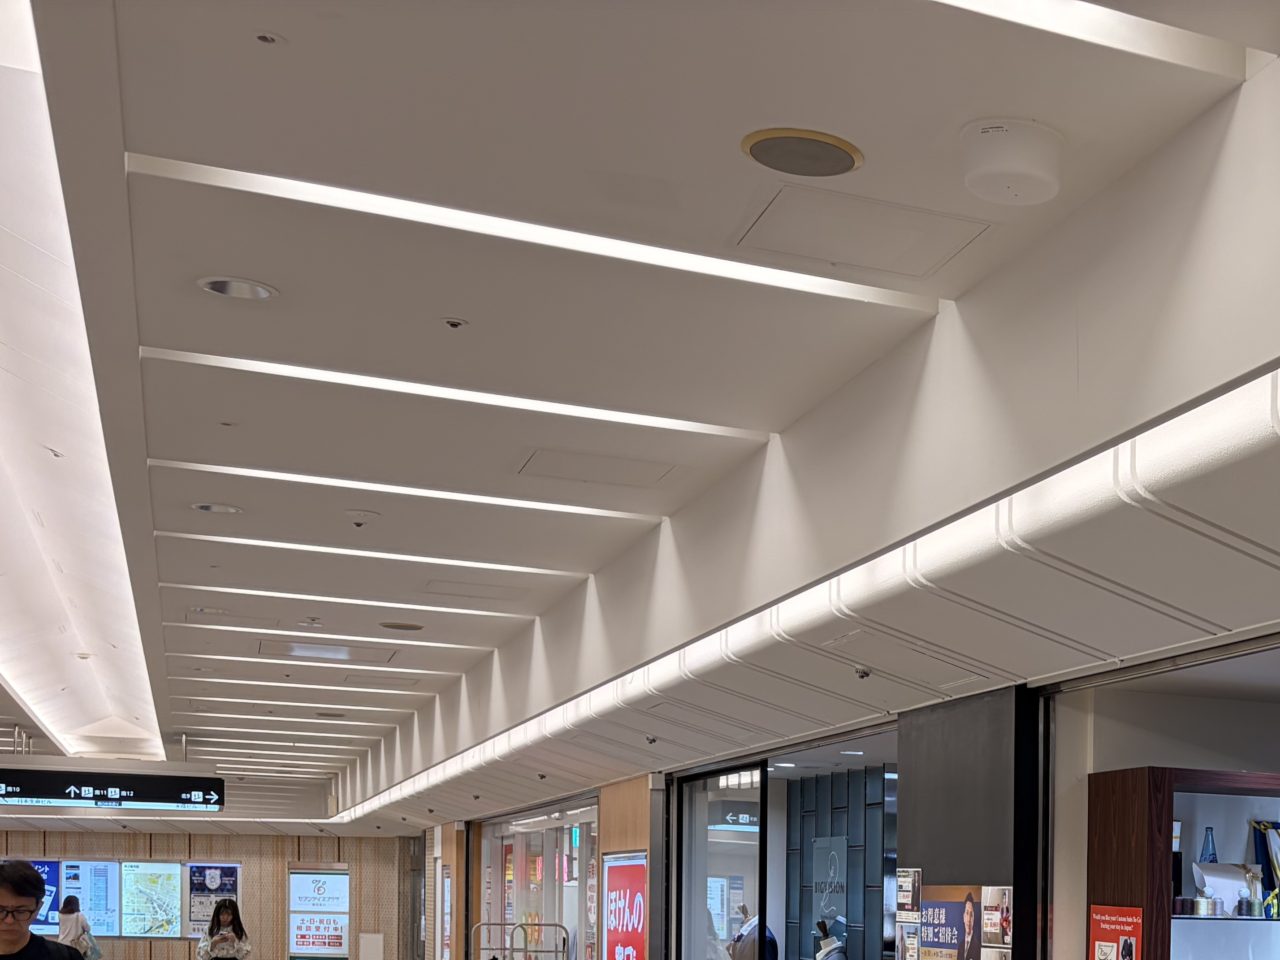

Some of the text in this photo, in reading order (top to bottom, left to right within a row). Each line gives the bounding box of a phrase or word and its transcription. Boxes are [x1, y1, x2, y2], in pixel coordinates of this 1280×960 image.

[607, 888, 644, 933] ほけんの
[922, 907, 946, 924] お得意様
[921, 926, 958, 944] 特別ご招待会
